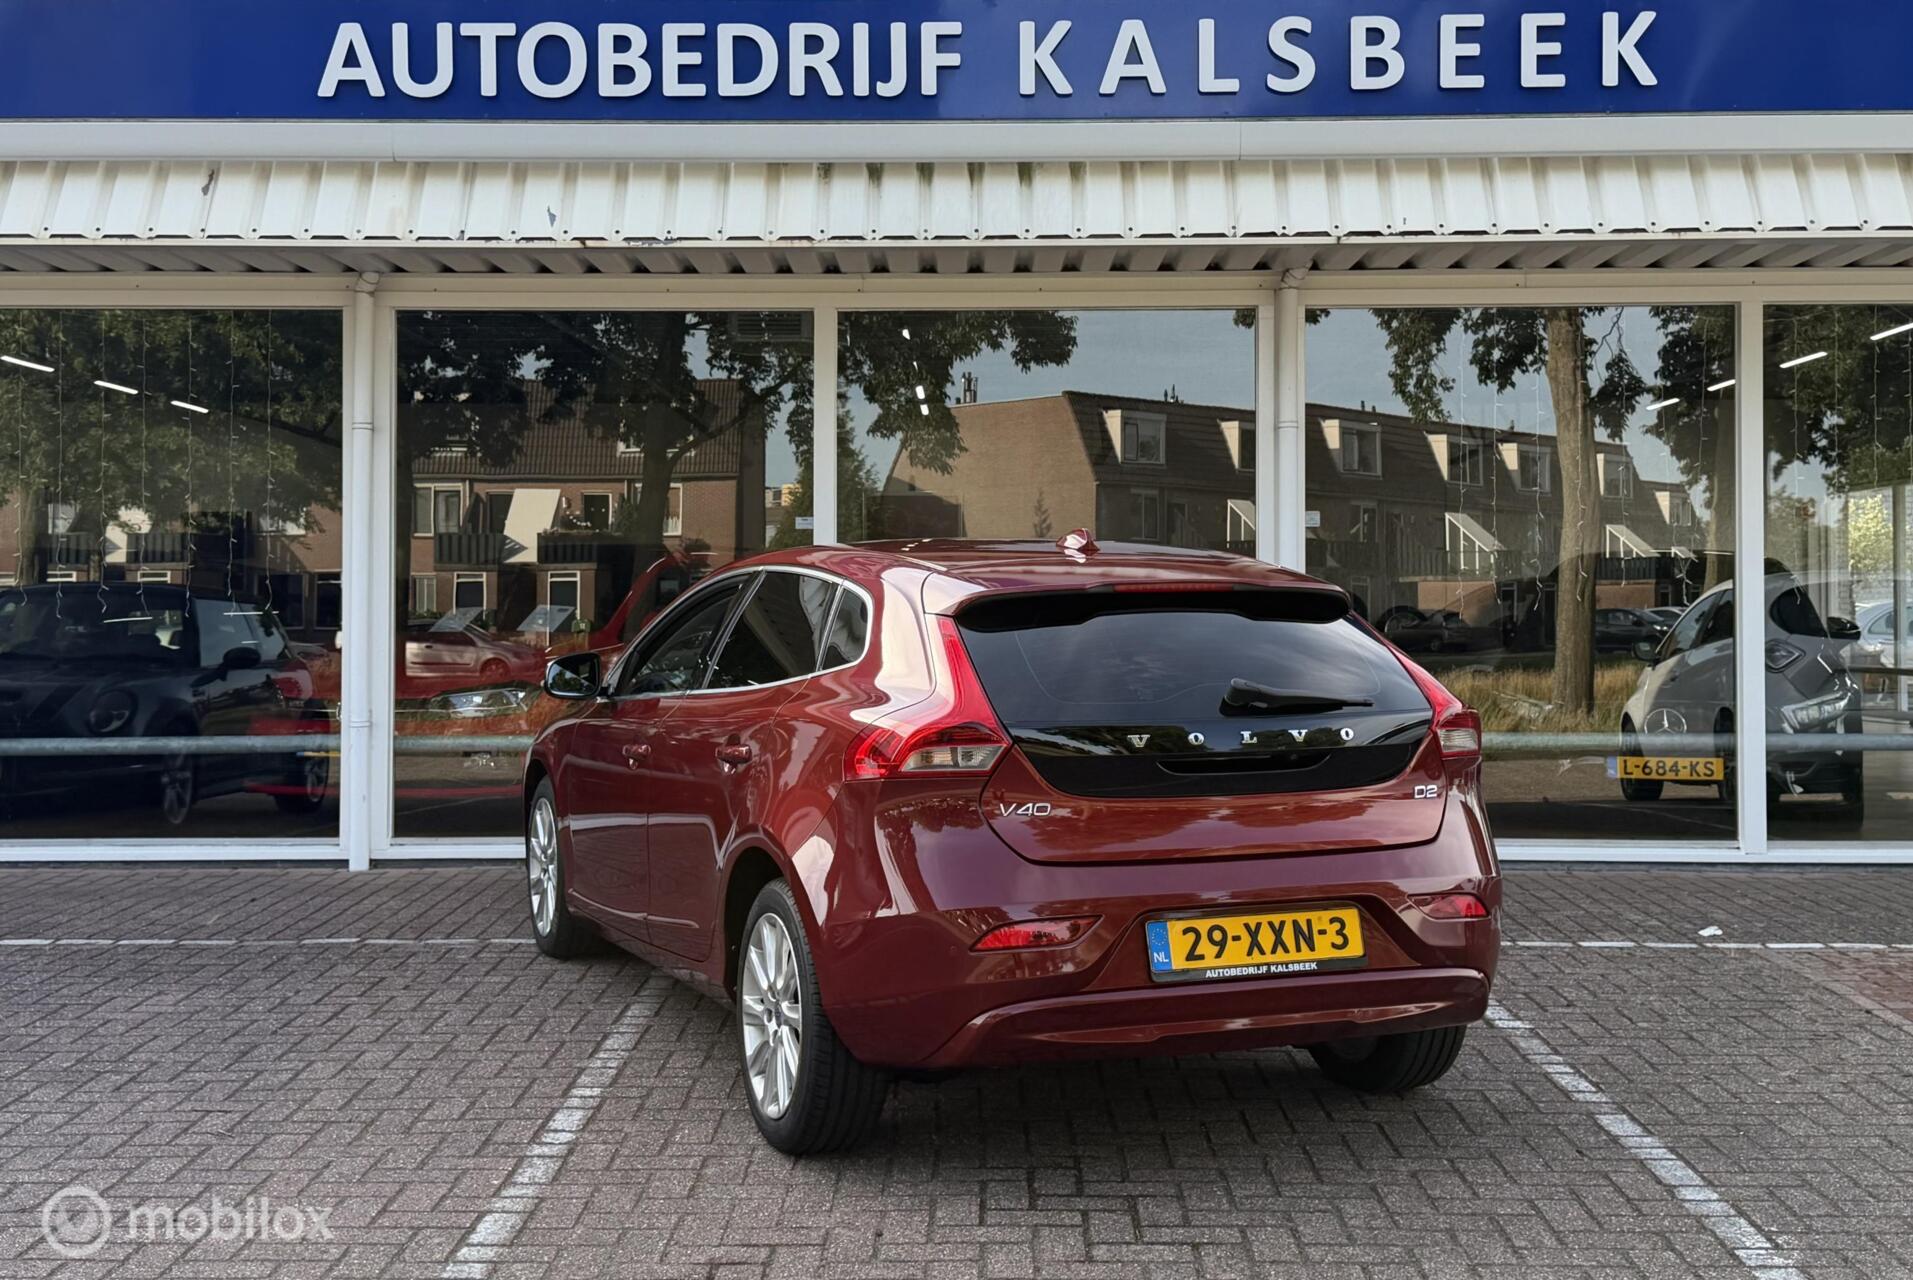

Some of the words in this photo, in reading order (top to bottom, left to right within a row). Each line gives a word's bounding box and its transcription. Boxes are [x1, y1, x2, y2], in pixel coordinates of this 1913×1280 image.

[317, 21, 963, 98] AUTOBEDRIJF
[1019, 11, 1657, 95] KALSBEEK
[1127, 727, 1354, 748] VOLVO
[1623, 760, 1715, 777] L-684-KS
[1414, 785, 1437, 798] D2
[999, 802, 1051, 817] V40
[1181, 916, 1350, 962] 29-XXN-3
[1153, 951, 1169, 963] NL
[1205, 966, 1268, 978] AUTOBEDRIJF
[1270, 961, 1318, 973] KALSBEEK
